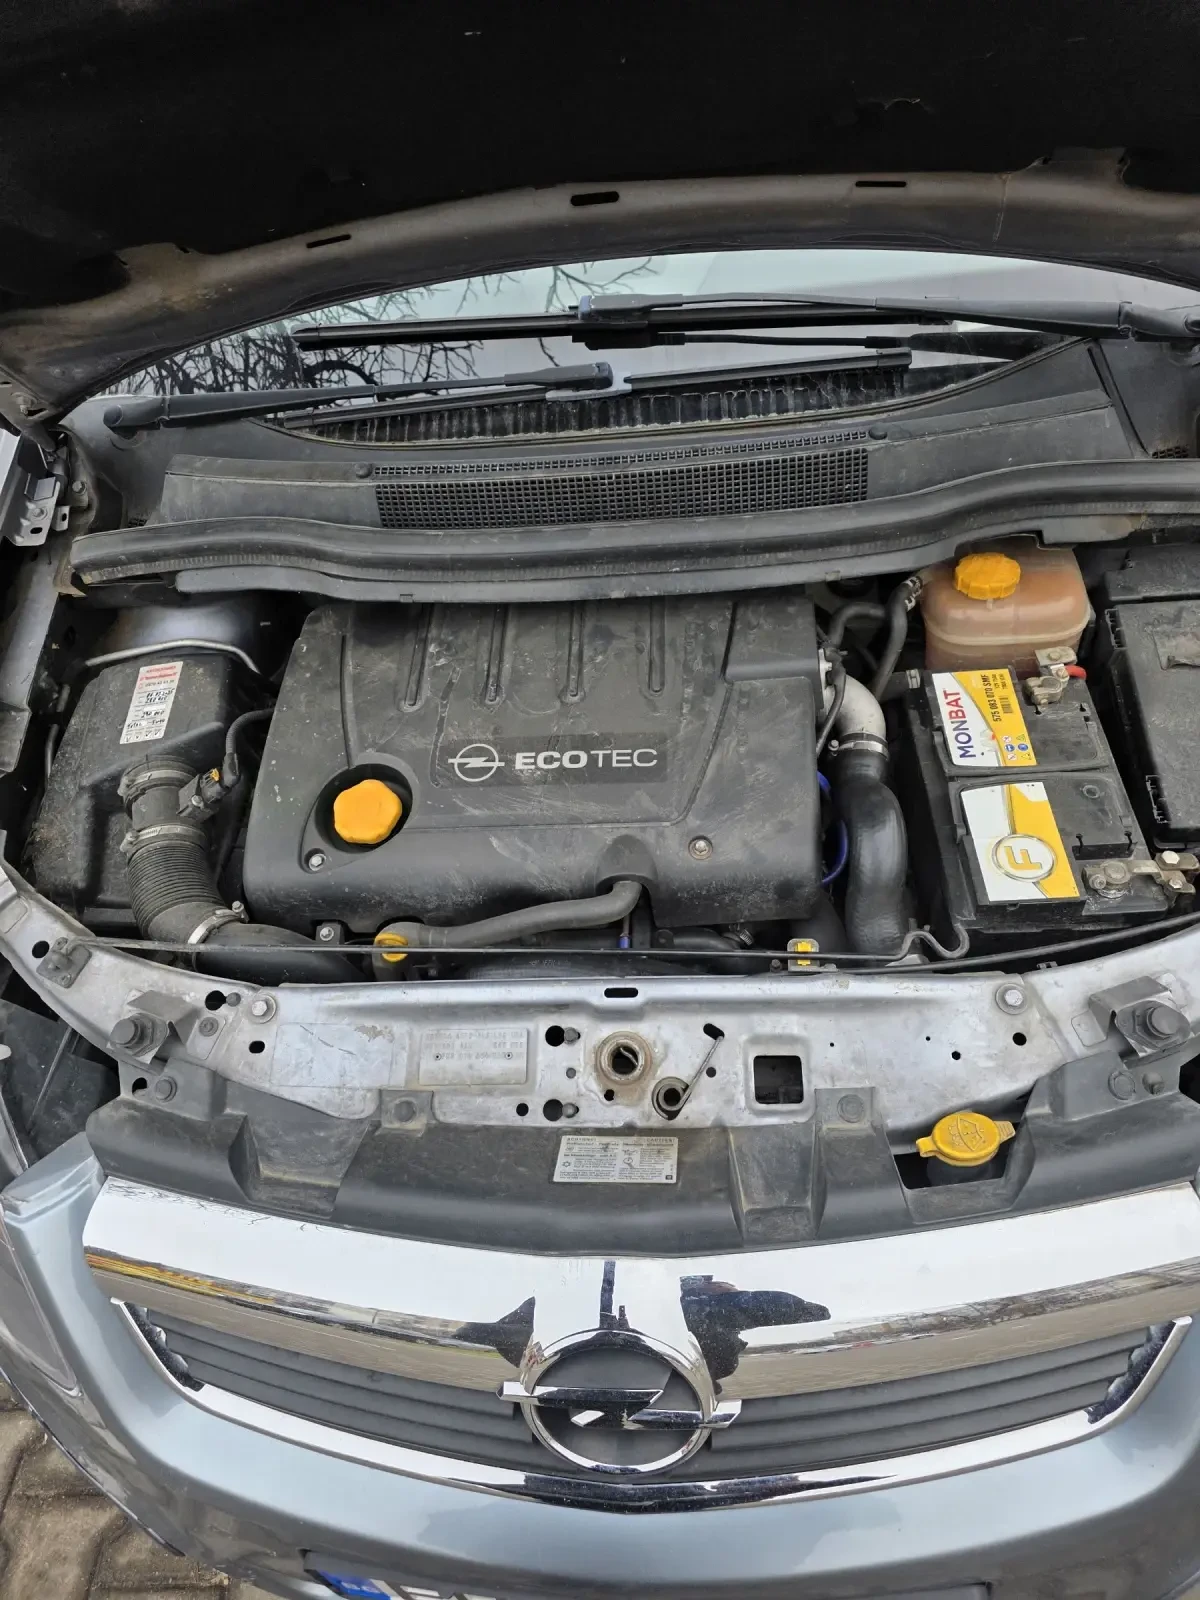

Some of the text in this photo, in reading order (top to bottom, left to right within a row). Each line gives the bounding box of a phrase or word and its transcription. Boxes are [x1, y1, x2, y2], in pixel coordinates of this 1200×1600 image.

[980, 674, 1002, 722] 575 083 070 SMF
[943, 690, 976, 758] MONBAT
[515, 748, 658, 770] ECOTEC
[1003, 845, 1042, 871] F
